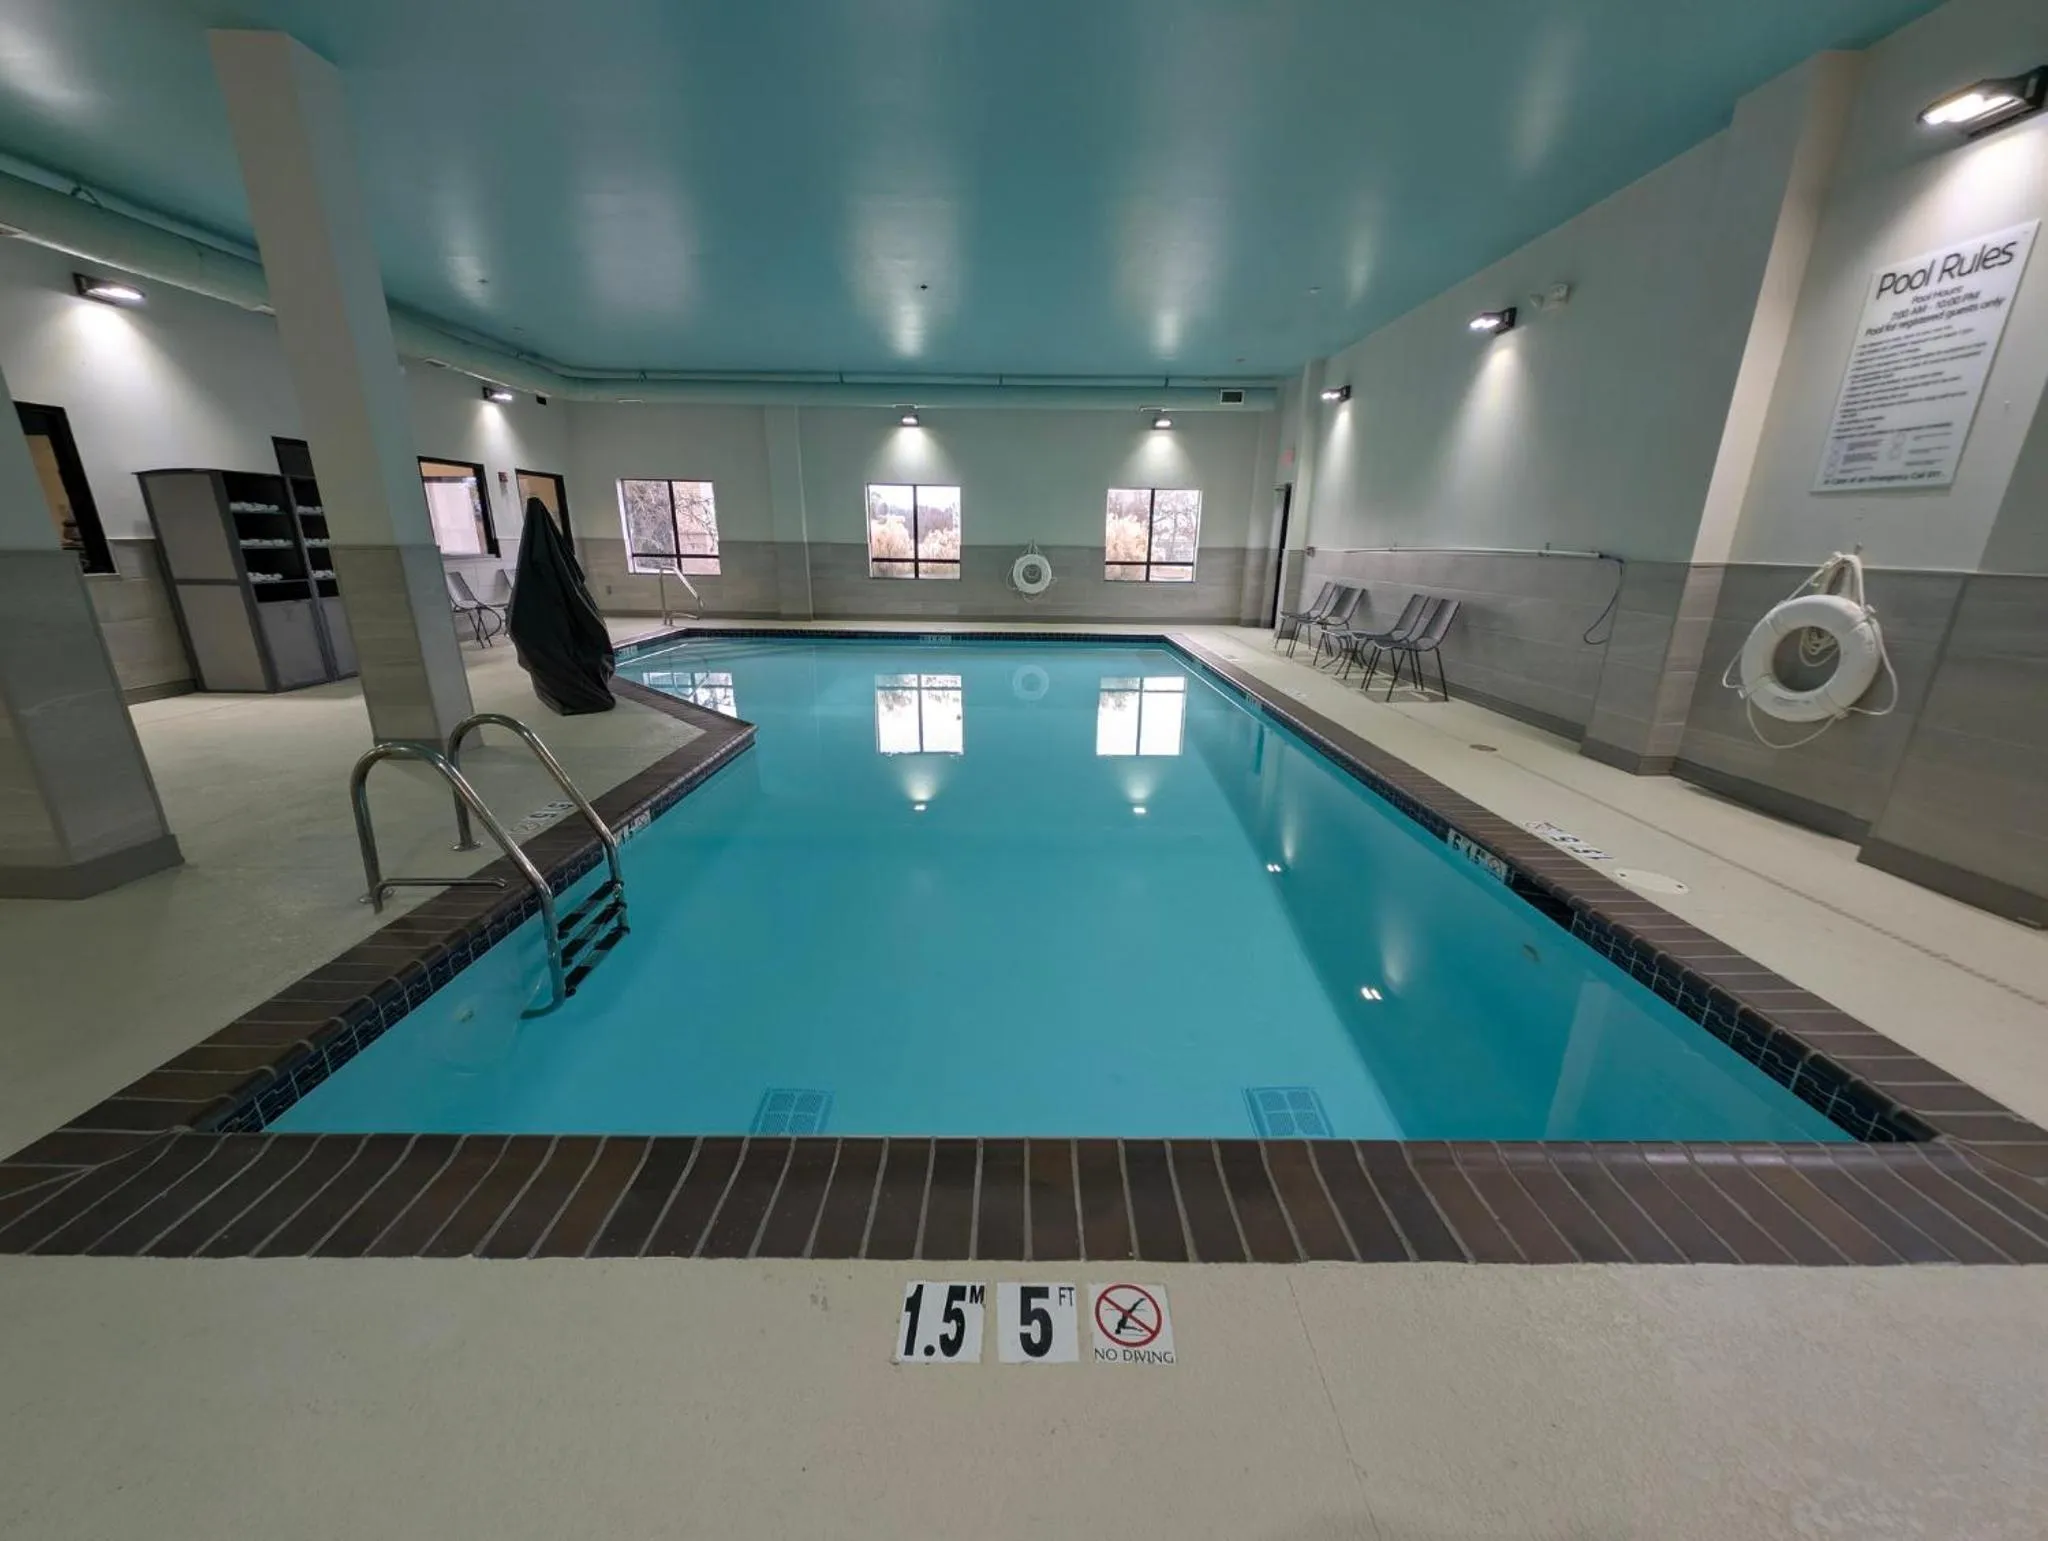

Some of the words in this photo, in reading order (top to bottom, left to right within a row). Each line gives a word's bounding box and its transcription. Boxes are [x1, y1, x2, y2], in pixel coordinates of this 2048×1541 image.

[1876, 258, 1935, 300] Pool
[1936, 241, 2018, 283] Rules
[1865, 325, 1885, 337] Pool
[1886, 321, 1898, 332] for
[1980, 297, 2007, 311] only
[1020, 1286, 1053, 1358] 5
[1058, 1287, 1075, 1306] FT
[1094, 1348, 1118, 1361] NO
[1122, 1349, 1174, 1364] DIVING
